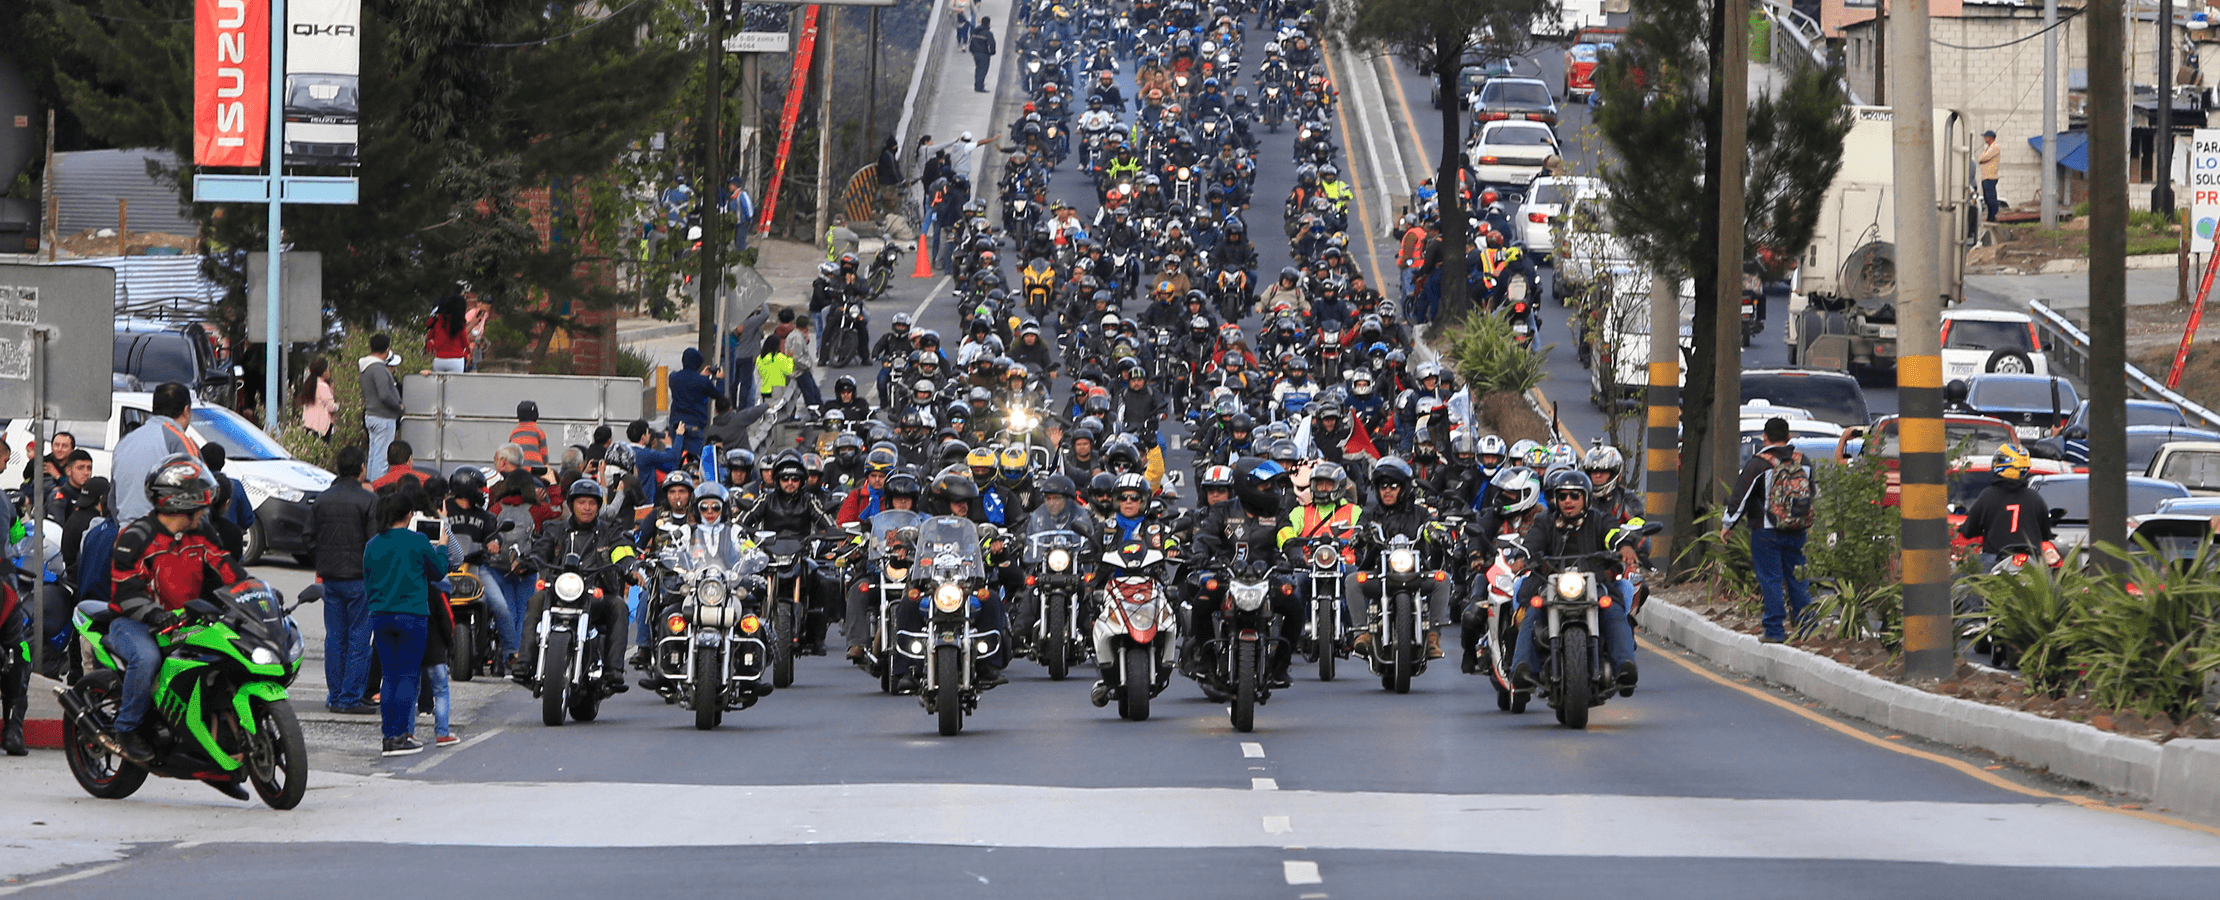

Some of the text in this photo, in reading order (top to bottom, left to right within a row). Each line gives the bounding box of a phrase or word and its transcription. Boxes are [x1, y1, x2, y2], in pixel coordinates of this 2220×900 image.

[217, 0, 245, 147] ISUZU
[310, 116, 337, 124] ISUZU
[2196, 141, 2220, 153] PAR
[2005, 503, 2021, 533] 7
